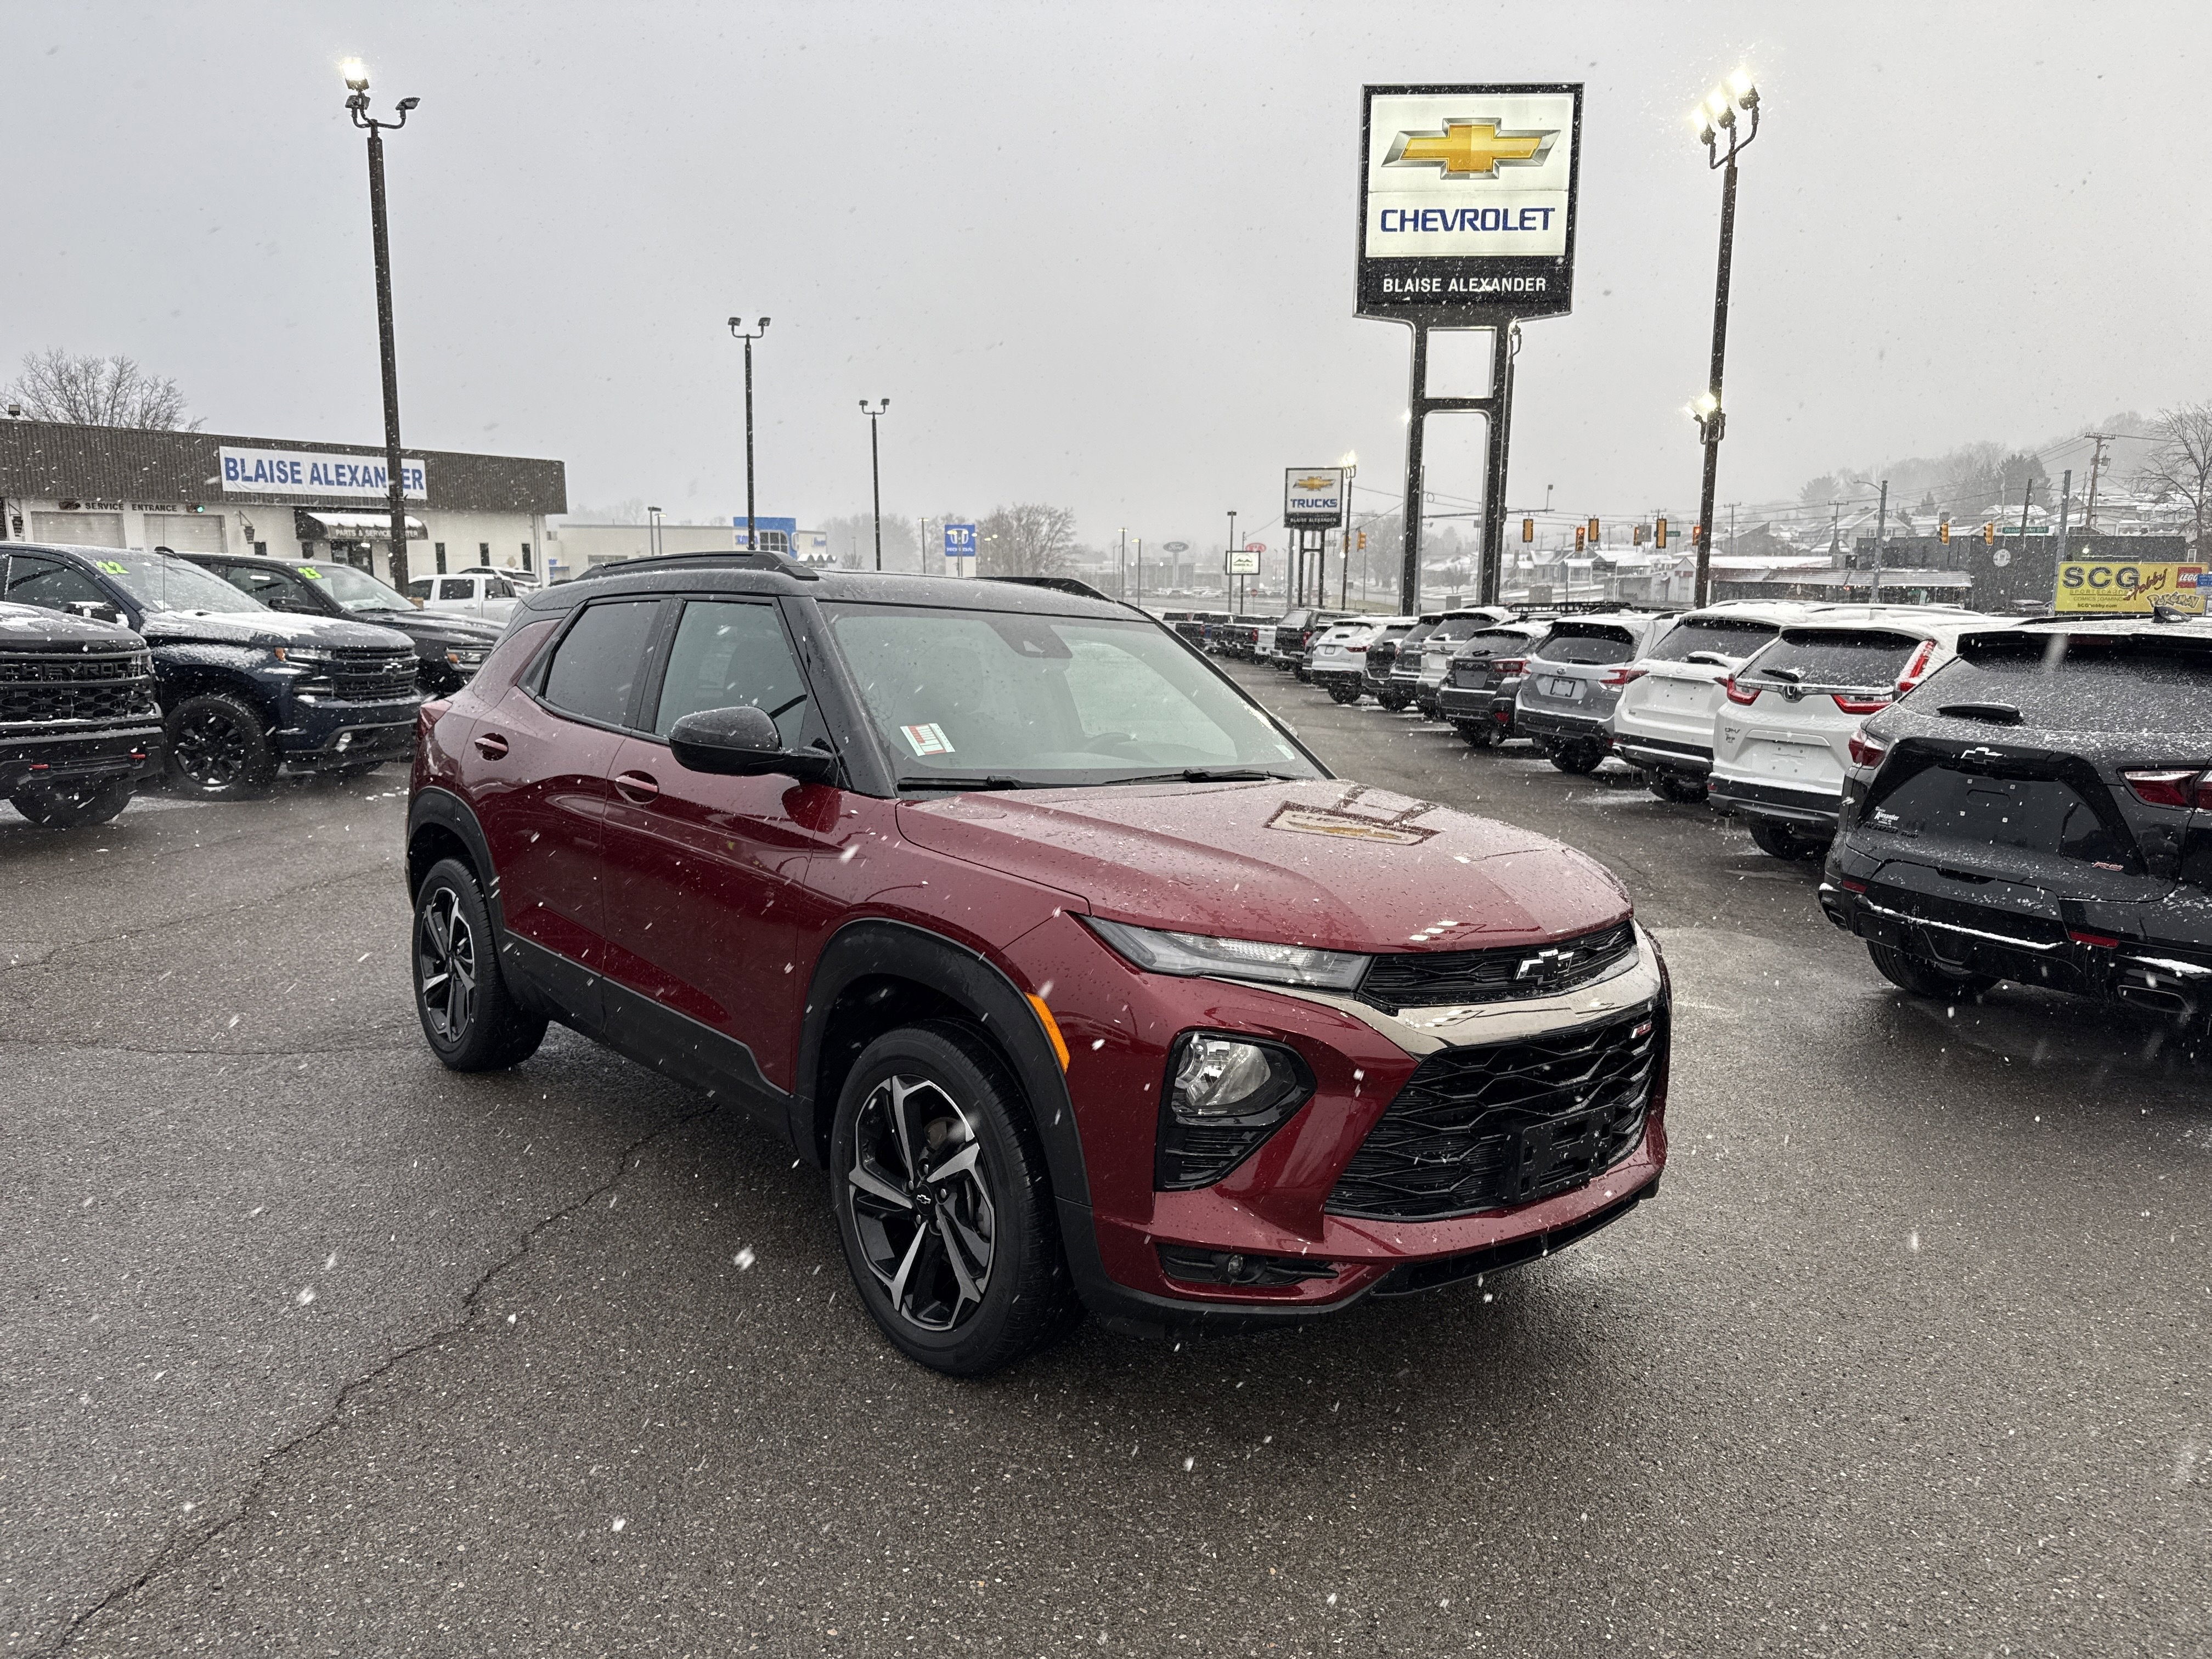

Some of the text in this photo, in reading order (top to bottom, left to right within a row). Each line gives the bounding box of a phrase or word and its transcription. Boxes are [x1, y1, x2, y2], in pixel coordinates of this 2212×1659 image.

[1381, 208, 1555, 232] CHEVROLET
[1383, 278, 1546, 292] BLAISE ALEXANDER
[224, 457, 424, 490] BLAISE ALEXANER
[85, 502, 177, 512] SERVICE ENTRANCE
[1290, 499, 1338, 508] TRUCKS
[96, 561, 131, 574] 22
[2062, 566, 2140, 589] SCG
[2179, 574, 2198, 582] LEGO
[1874, 811, 1900, 821] Alexander
[2092, 861, 2124, 872] RS
[1631, 1022, 1652, 1039] RS
